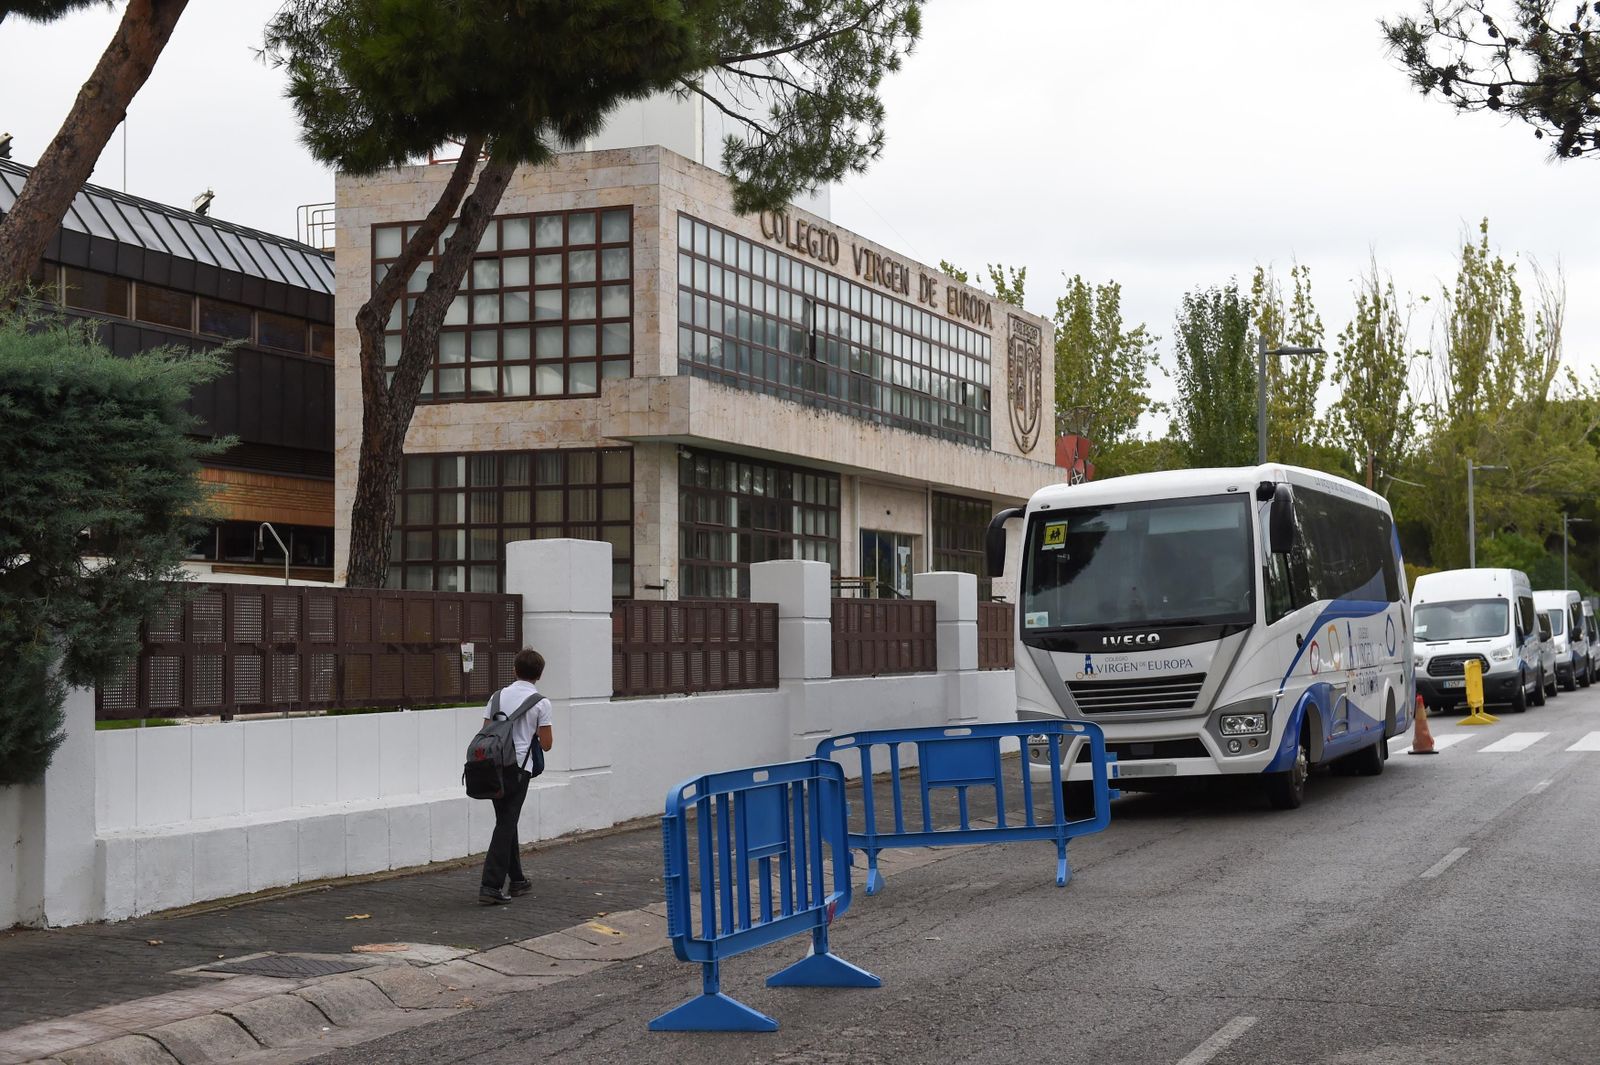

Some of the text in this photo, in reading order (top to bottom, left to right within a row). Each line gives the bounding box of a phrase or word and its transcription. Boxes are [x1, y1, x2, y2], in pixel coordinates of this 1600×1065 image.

[760, 209, 839, 266] COLEGIO
[852, 243, 910, 296] VIRGEN
[919, 271, 938, 308] DE
[947, 285, 993, 330] EUROPA
[1102, 633, 1160, 646] IVECO
[1096, 662, 1138, 674] VIRGEN
[1147, 658, 1193, 671] EUROPA
